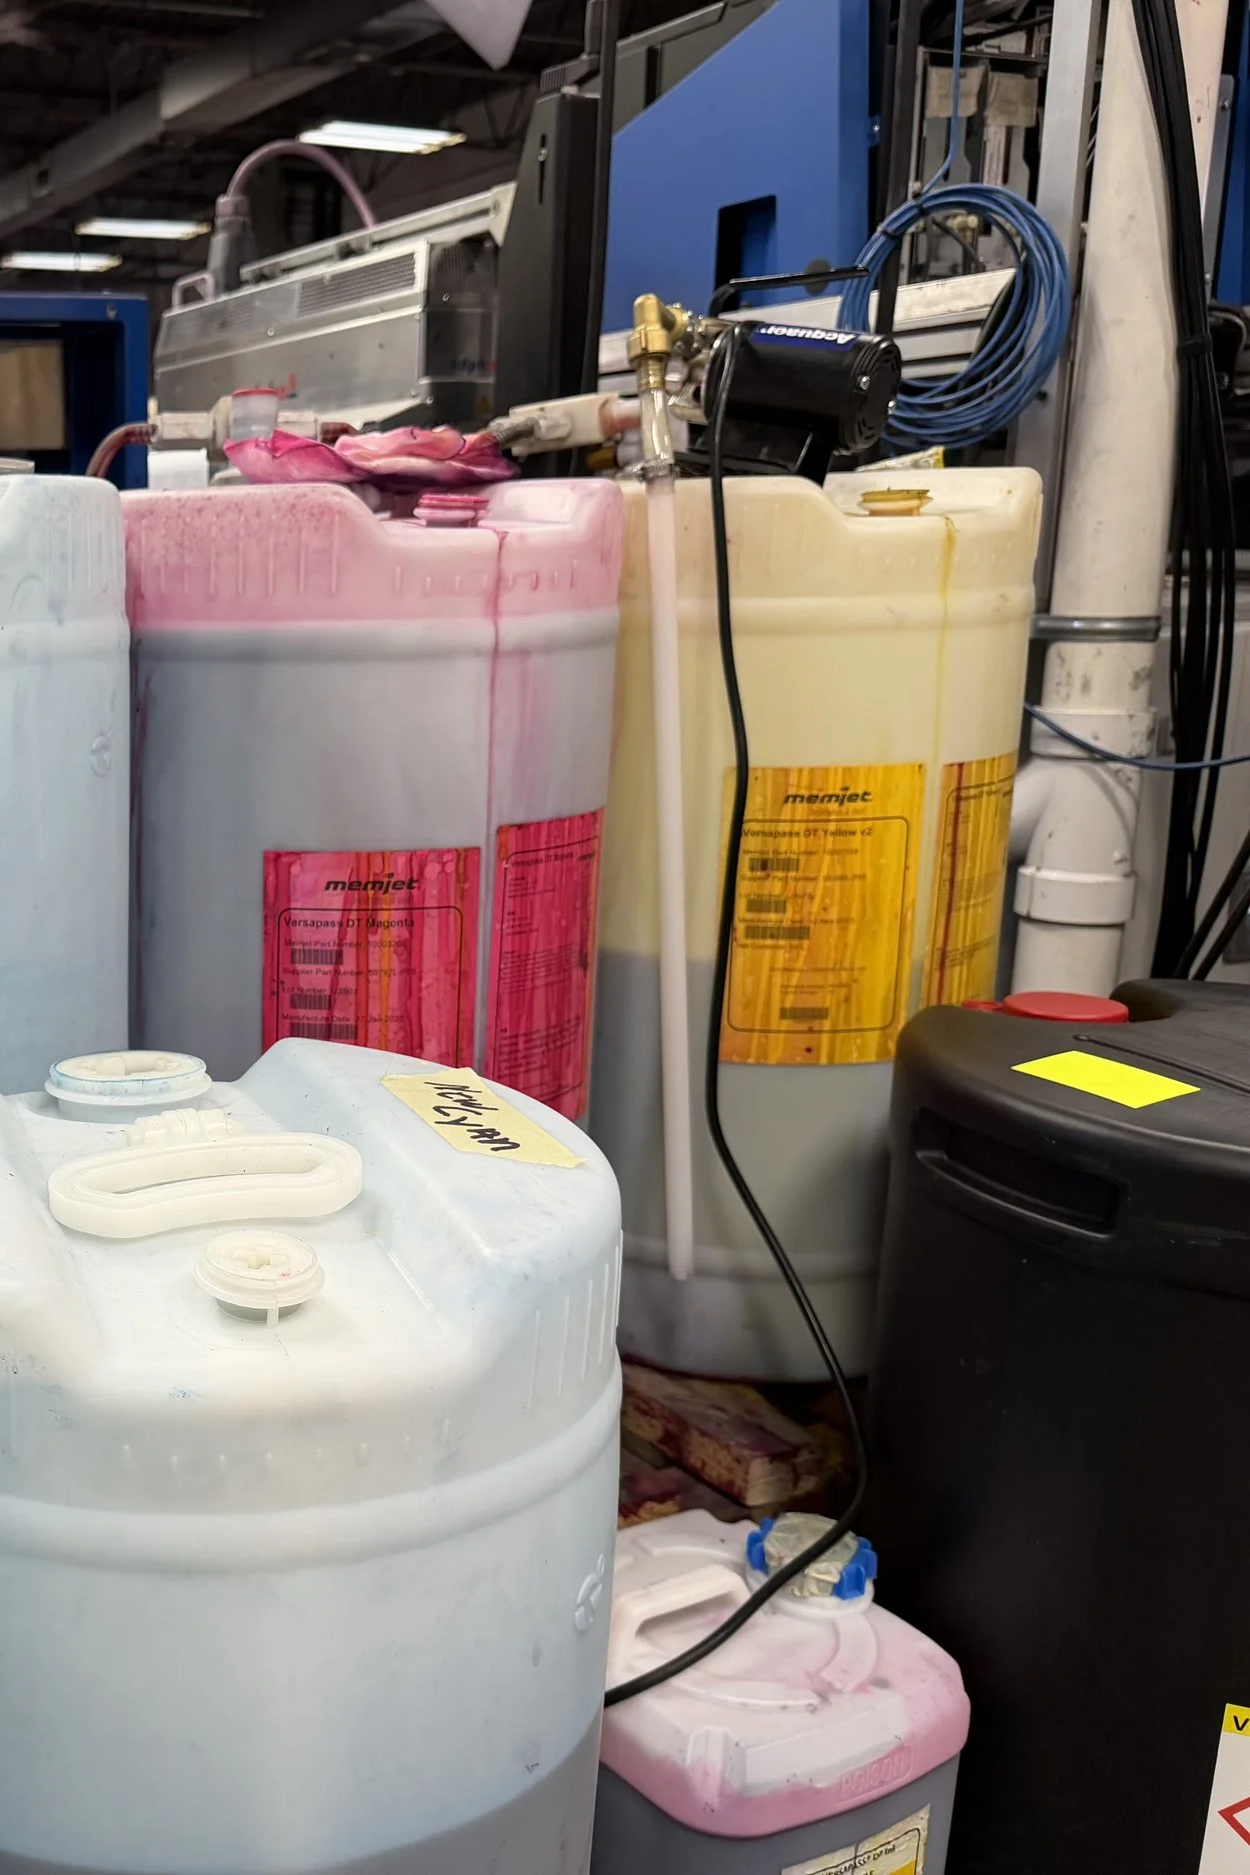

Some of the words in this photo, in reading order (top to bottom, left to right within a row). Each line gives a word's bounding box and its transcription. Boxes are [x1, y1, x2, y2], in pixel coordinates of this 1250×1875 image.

[782, 786, 872, 807] memjet
[822, 828, 857, 838] Yellow
[324, 872, 419, 896] memjet
[283, 916, 343, 929] Versapass
[346, 918, 363, 928] DT
[366, 917, 415, 929] Magenta
[840, 1750, 906, 1798] POISON
